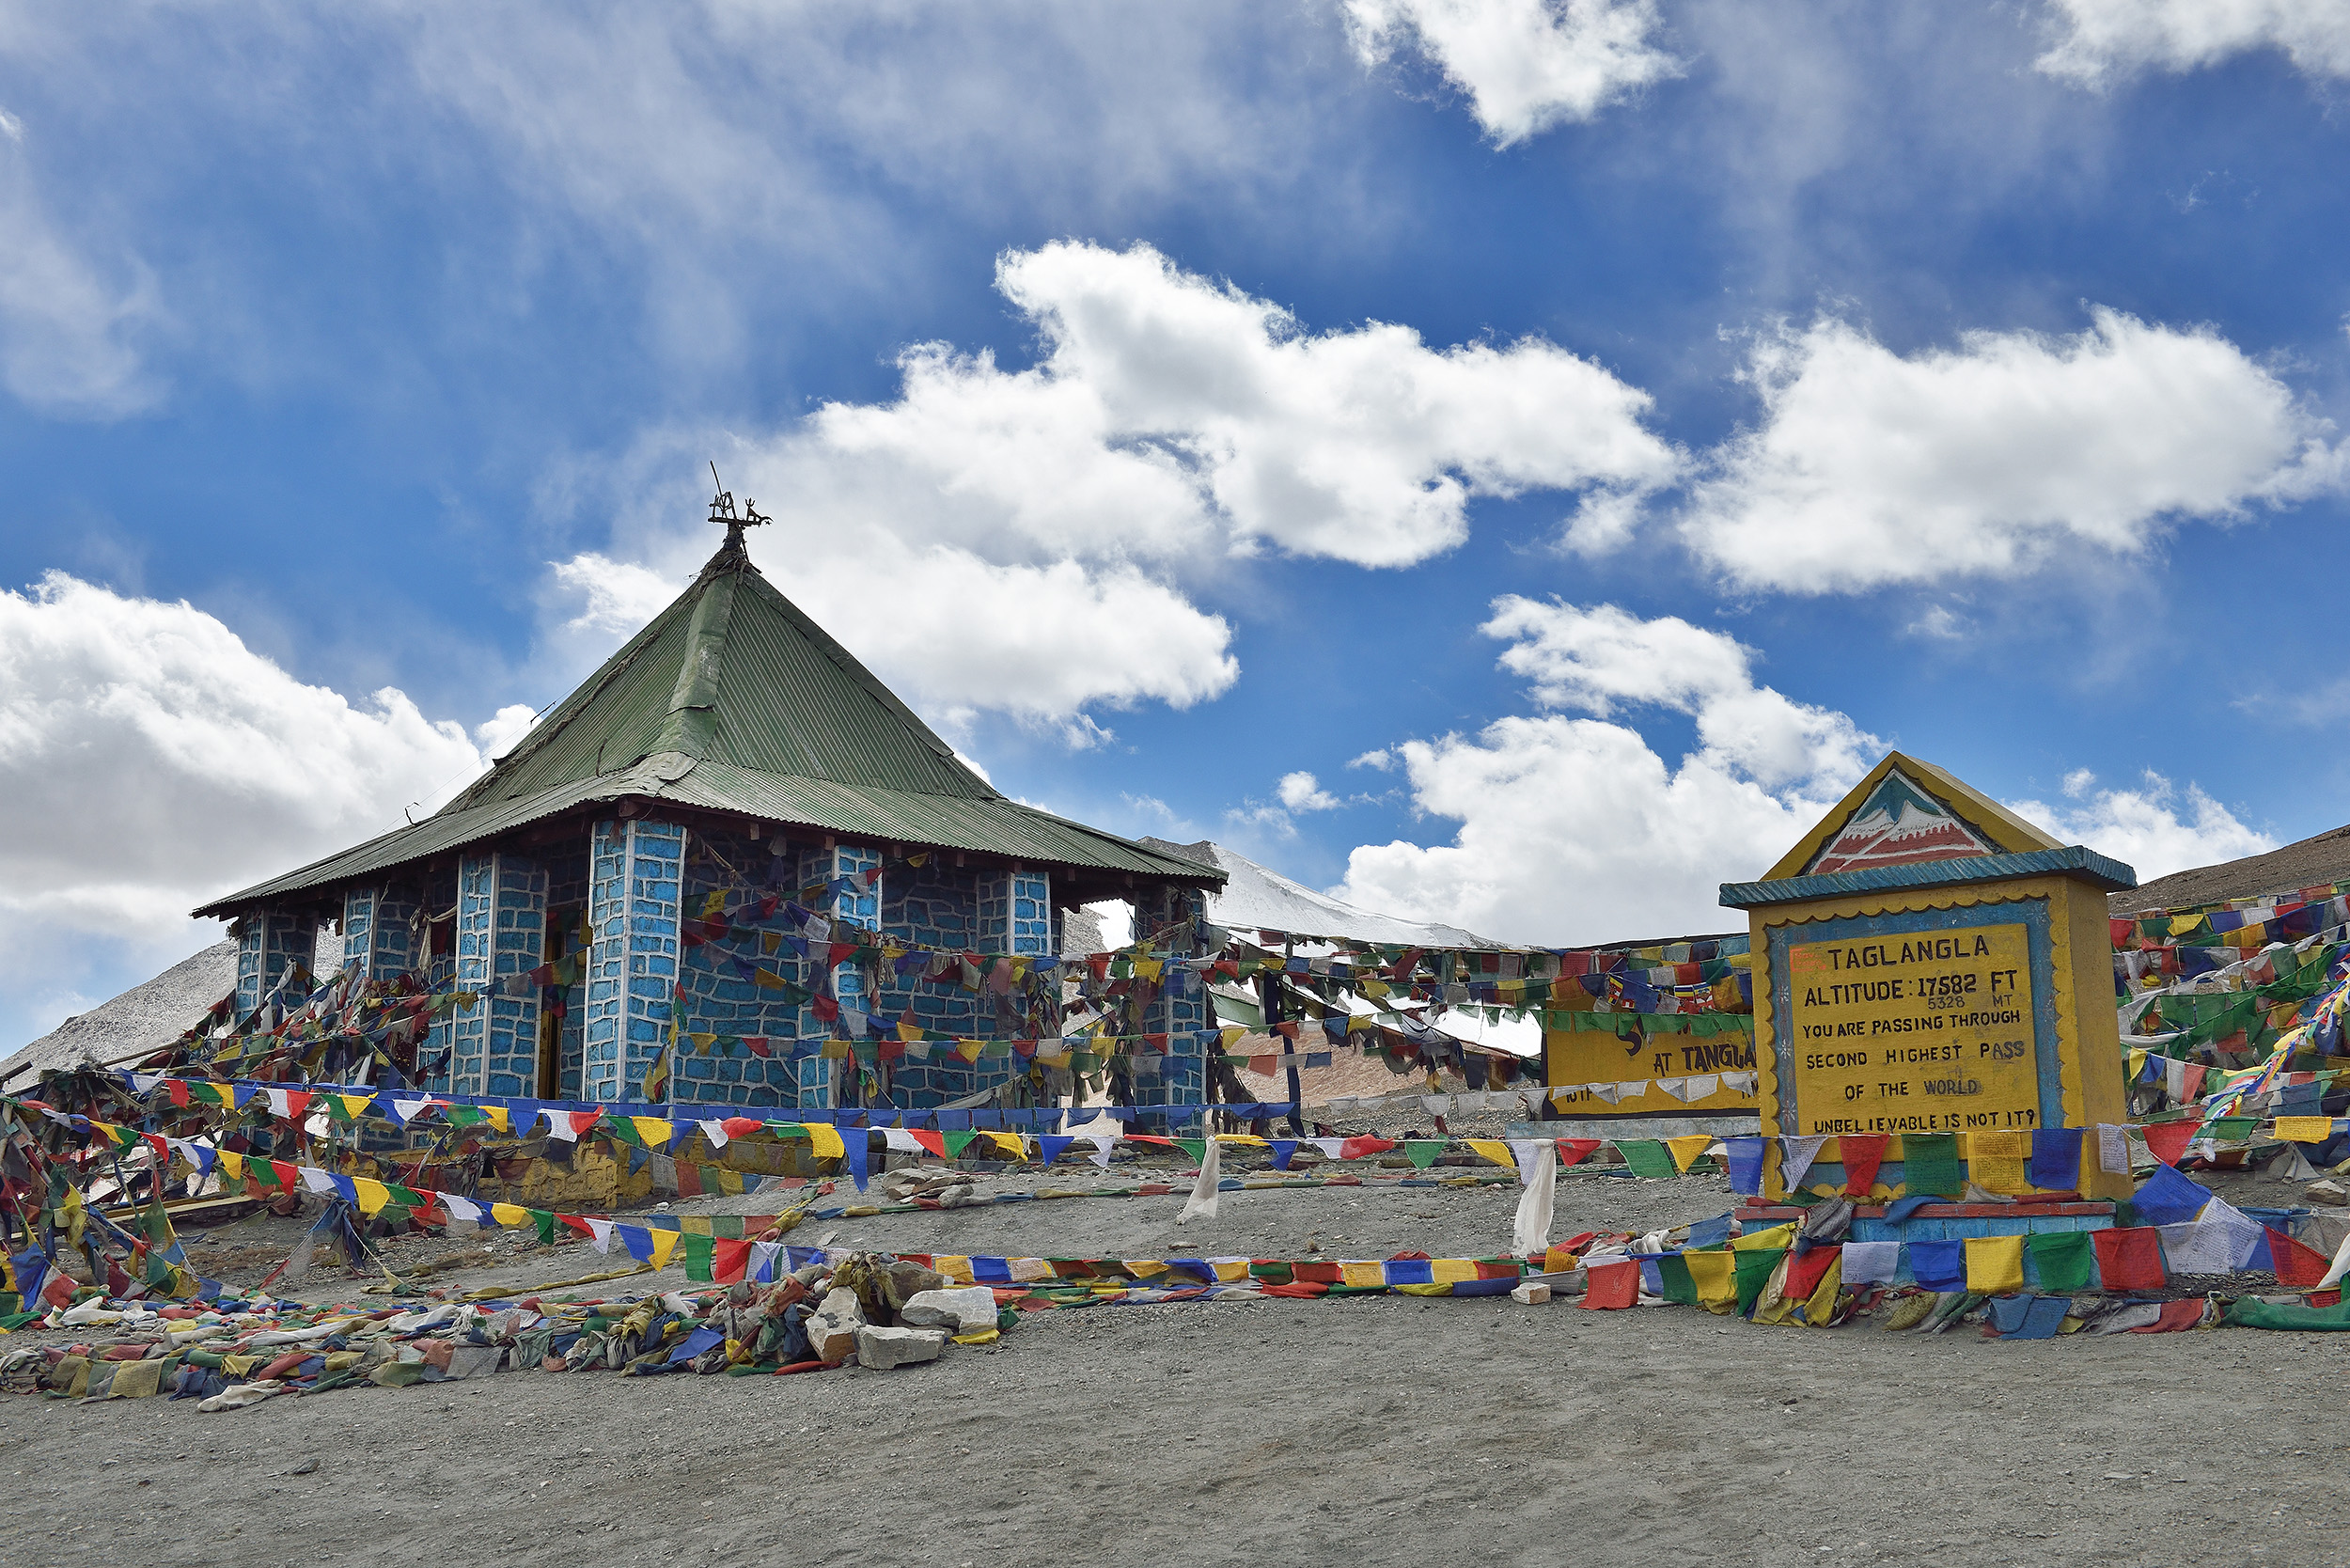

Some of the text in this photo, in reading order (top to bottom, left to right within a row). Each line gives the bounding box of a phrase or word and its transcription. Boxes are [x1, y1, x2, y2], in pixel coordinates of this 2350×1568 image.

[1827, 934, 1989, 971] TAGLANGLA
[1918, 973, 1977, 997] 17582
[1991, 969, 2018, 993] FT
[1927, 994, 2013, 1010] 5328 MT
[1802, 1010, 2020, 1039] YOU ARE PASSING THROUGH
[1653, 1043, 1757, 1077] AT TANGLA
[1807, 1040, 2025, 1069] SECOND HIGHEST PASS
[1844, 1079, 1978, 1100] OF THE WORLD
[1814, 1114, 1936, 1133] UNBELIEVABLE
[1944, 1111, 1960, 1128] IS
[1966, 1111, 1998, 1127] NOT
